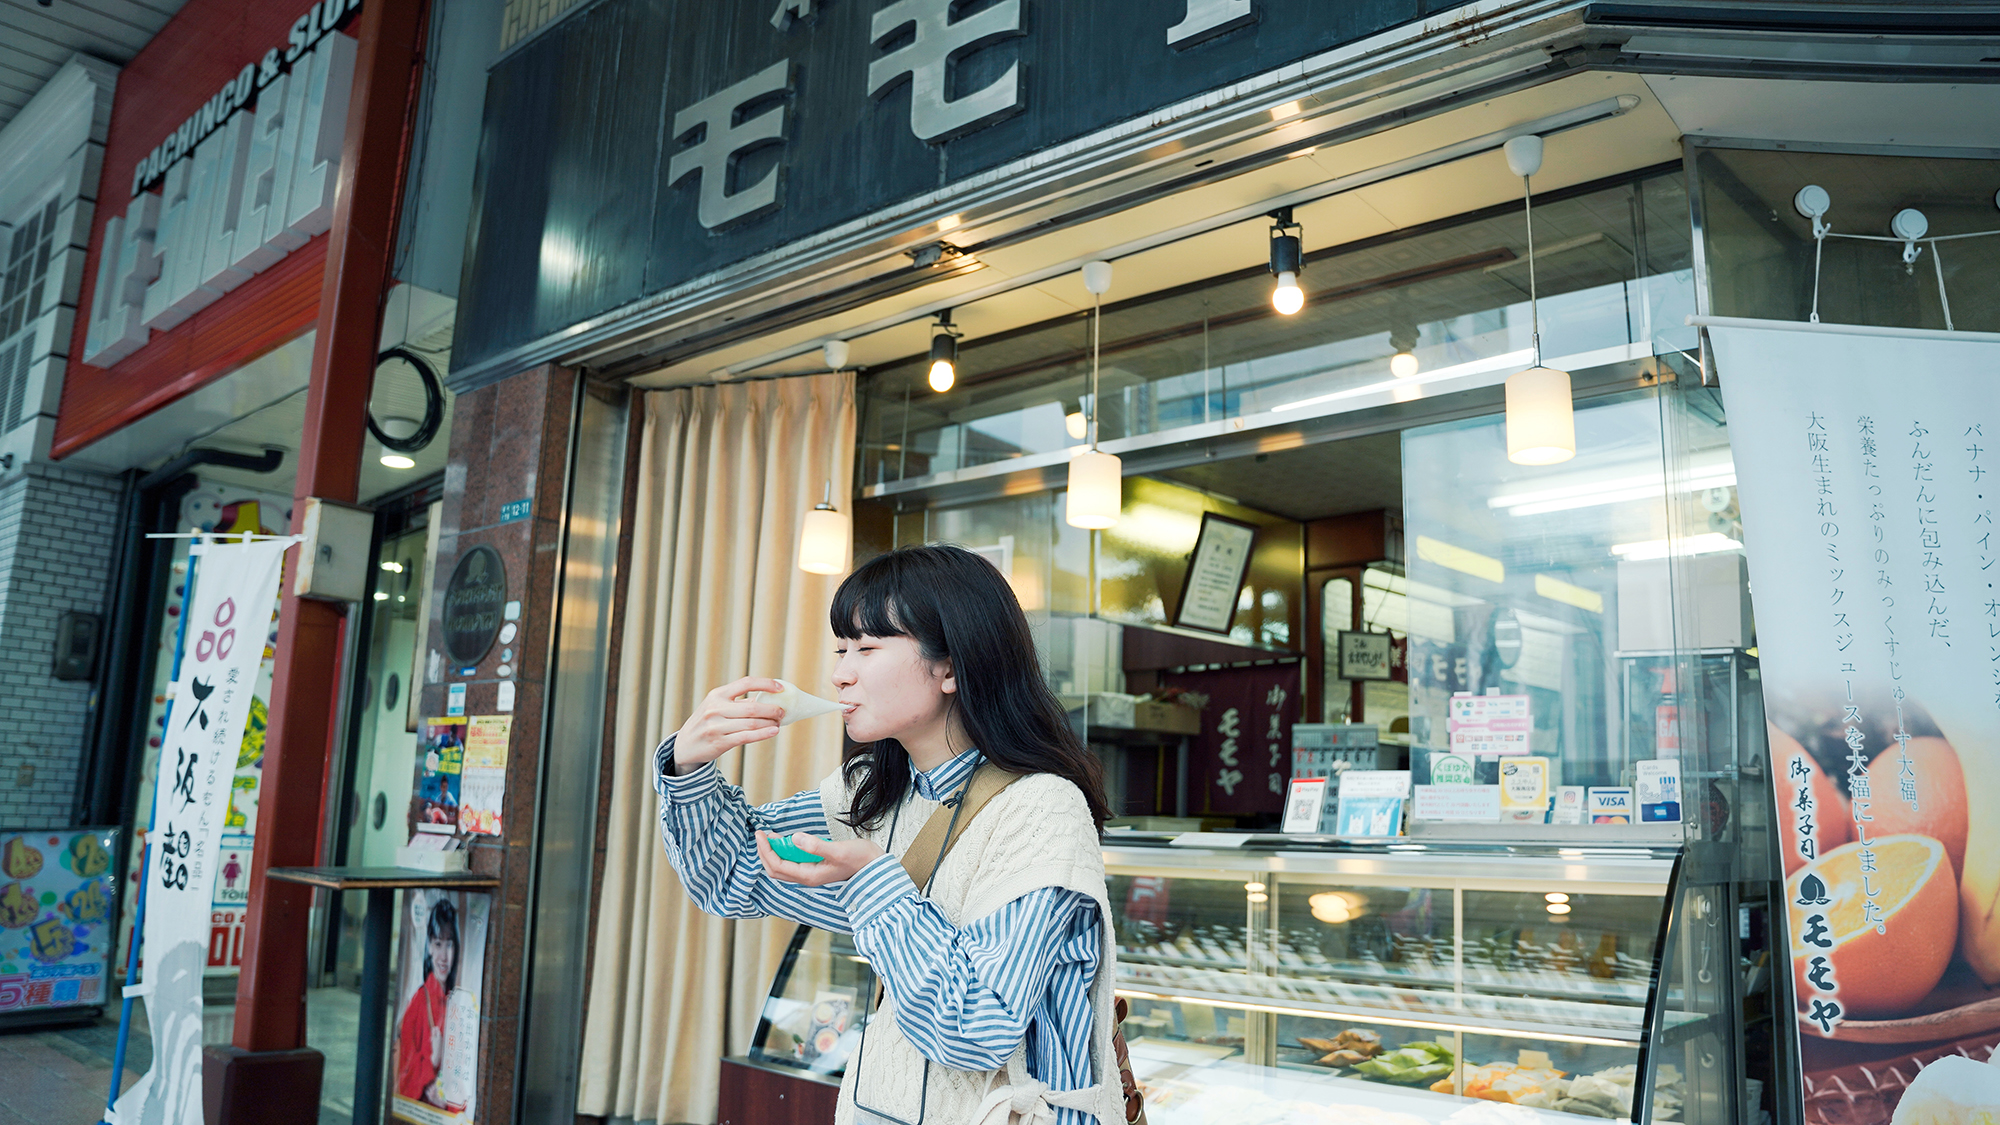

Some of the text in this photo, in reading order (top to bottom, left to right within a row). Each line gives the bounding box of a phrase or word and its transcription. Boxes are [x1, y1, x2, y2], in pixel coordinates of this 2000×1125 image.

[131, 0, 361, 197] PACHINCO & SLO
[1908, 420, 1951, 648] ふんだんに包み込んだ、
[1805, 411, 1887, 935] 大阪生まれのミックスジュースを大福にしました。
[1857, 415, 1919, 812] 栄養たっぷりのみっくすじゅーす大福。
[1216, 708, 1243, 796] モモヤ
[1598, 797, 1625, 806] VISA
[1790, 757, 1815, 860] 御菓子司
[1802, 914, 1841, 1033] モモヤ
